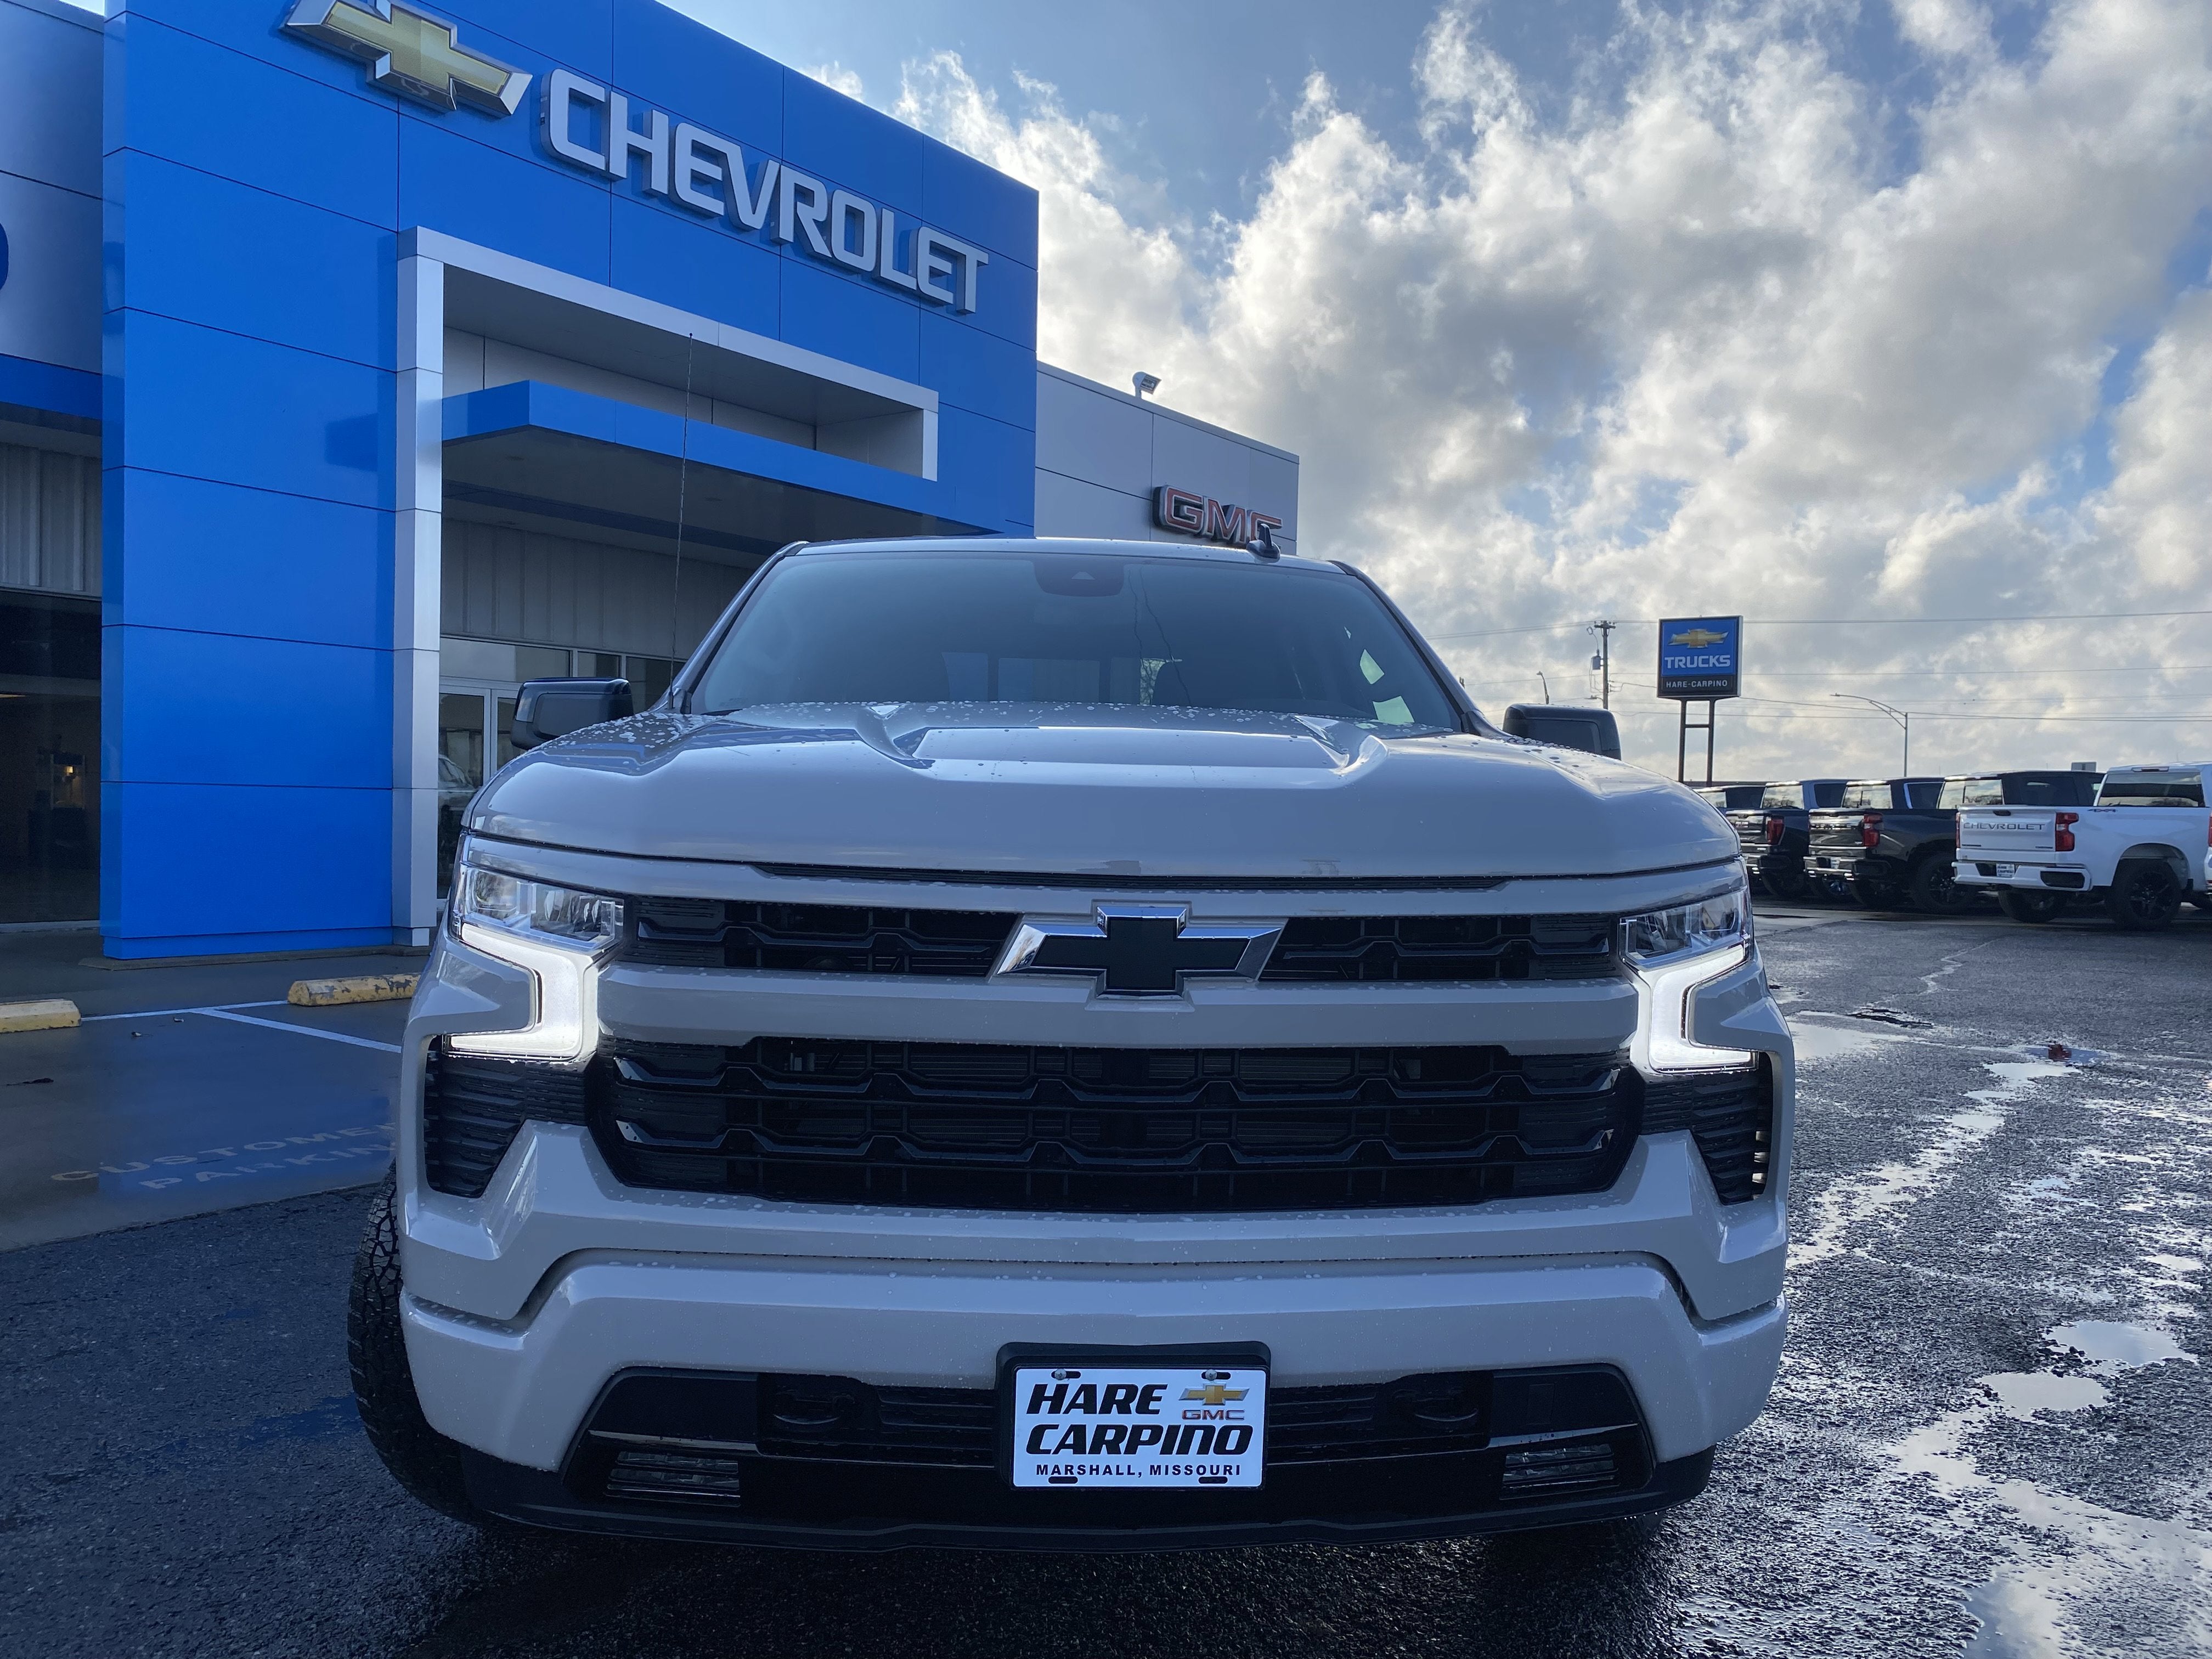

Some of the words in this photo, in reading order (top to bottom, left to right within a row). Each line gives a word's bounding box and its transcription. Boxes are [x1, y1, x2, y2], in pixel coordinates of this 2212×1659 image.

[541, 69, 989, 314] CHEVROLET
[1664, 654, 1731, 669] TRUCKS
[1666, 680, 1728, 688] HARE-CARPINO
[138, 1142, 396, 1189] PARKIN
[1026, 1383, 1169, 1414] HARE
[1182, 1409, 1245, 1420] GMC
[1025, 1424, 1254, 1455] CARPINO
[1036, 1464, 1142, 1478] MARSHALL,
[1149, 1464, 1241, 1476] MISSOURI
